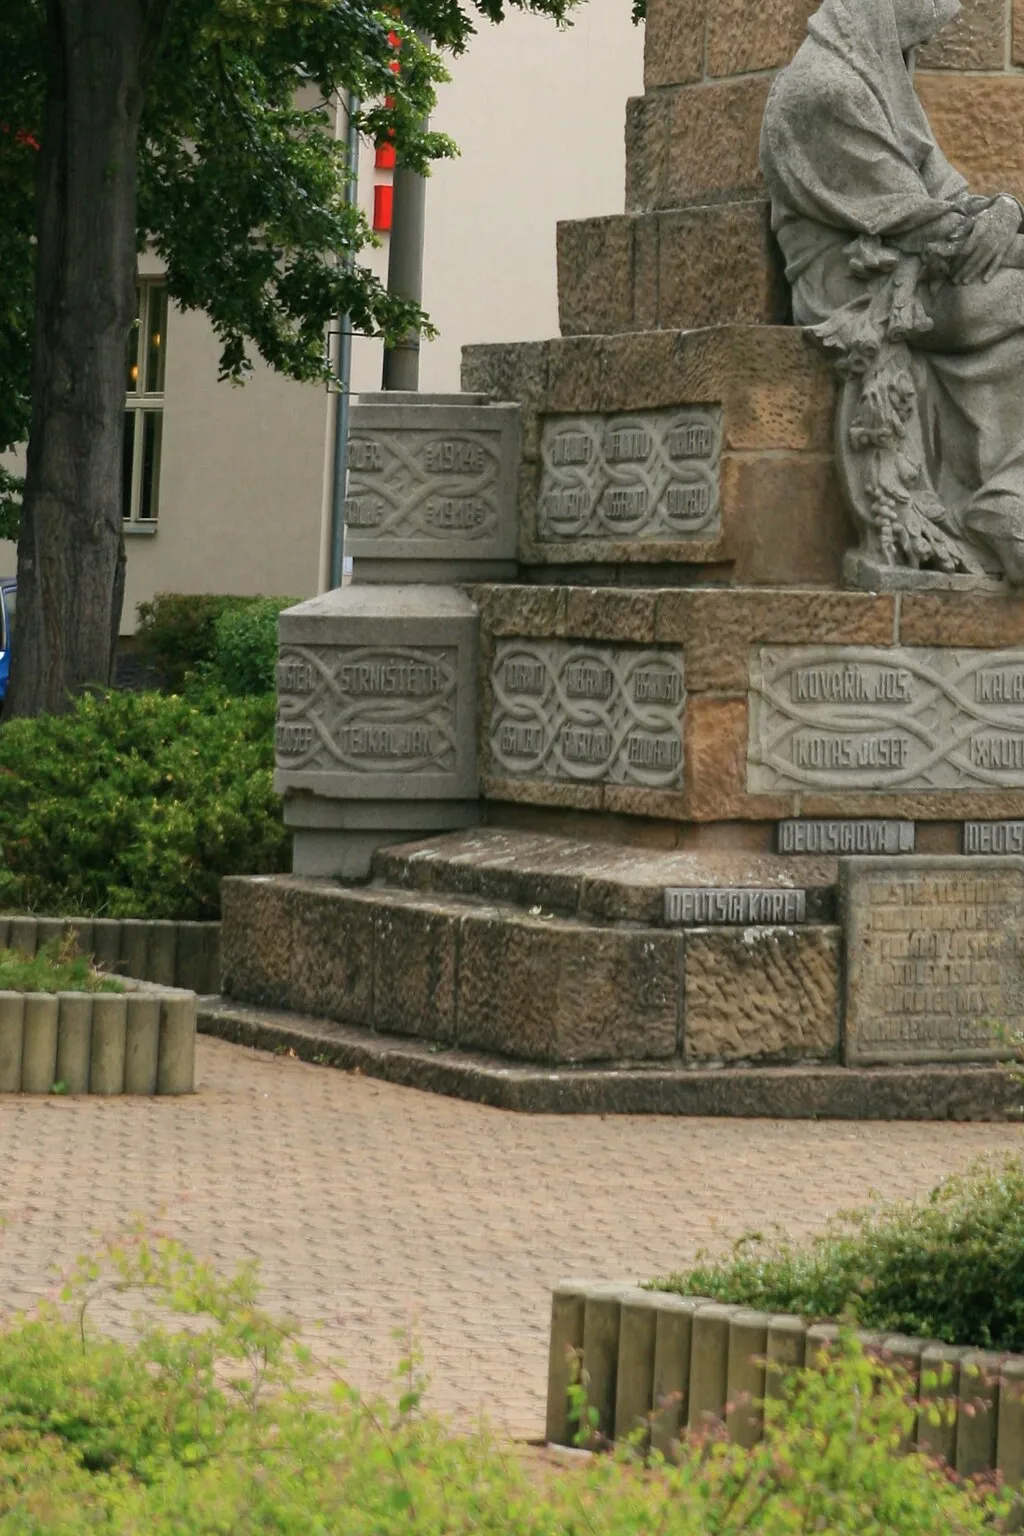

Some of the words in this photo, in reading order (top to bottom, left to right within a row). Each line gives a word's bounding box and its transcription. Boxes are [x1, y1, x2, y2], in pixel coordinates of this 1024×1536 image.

[856, 737, 908, 768] JOSEF
[670, 892, 744, 922] DEUTSCH
[749, 892, 806, 923] KAREL
